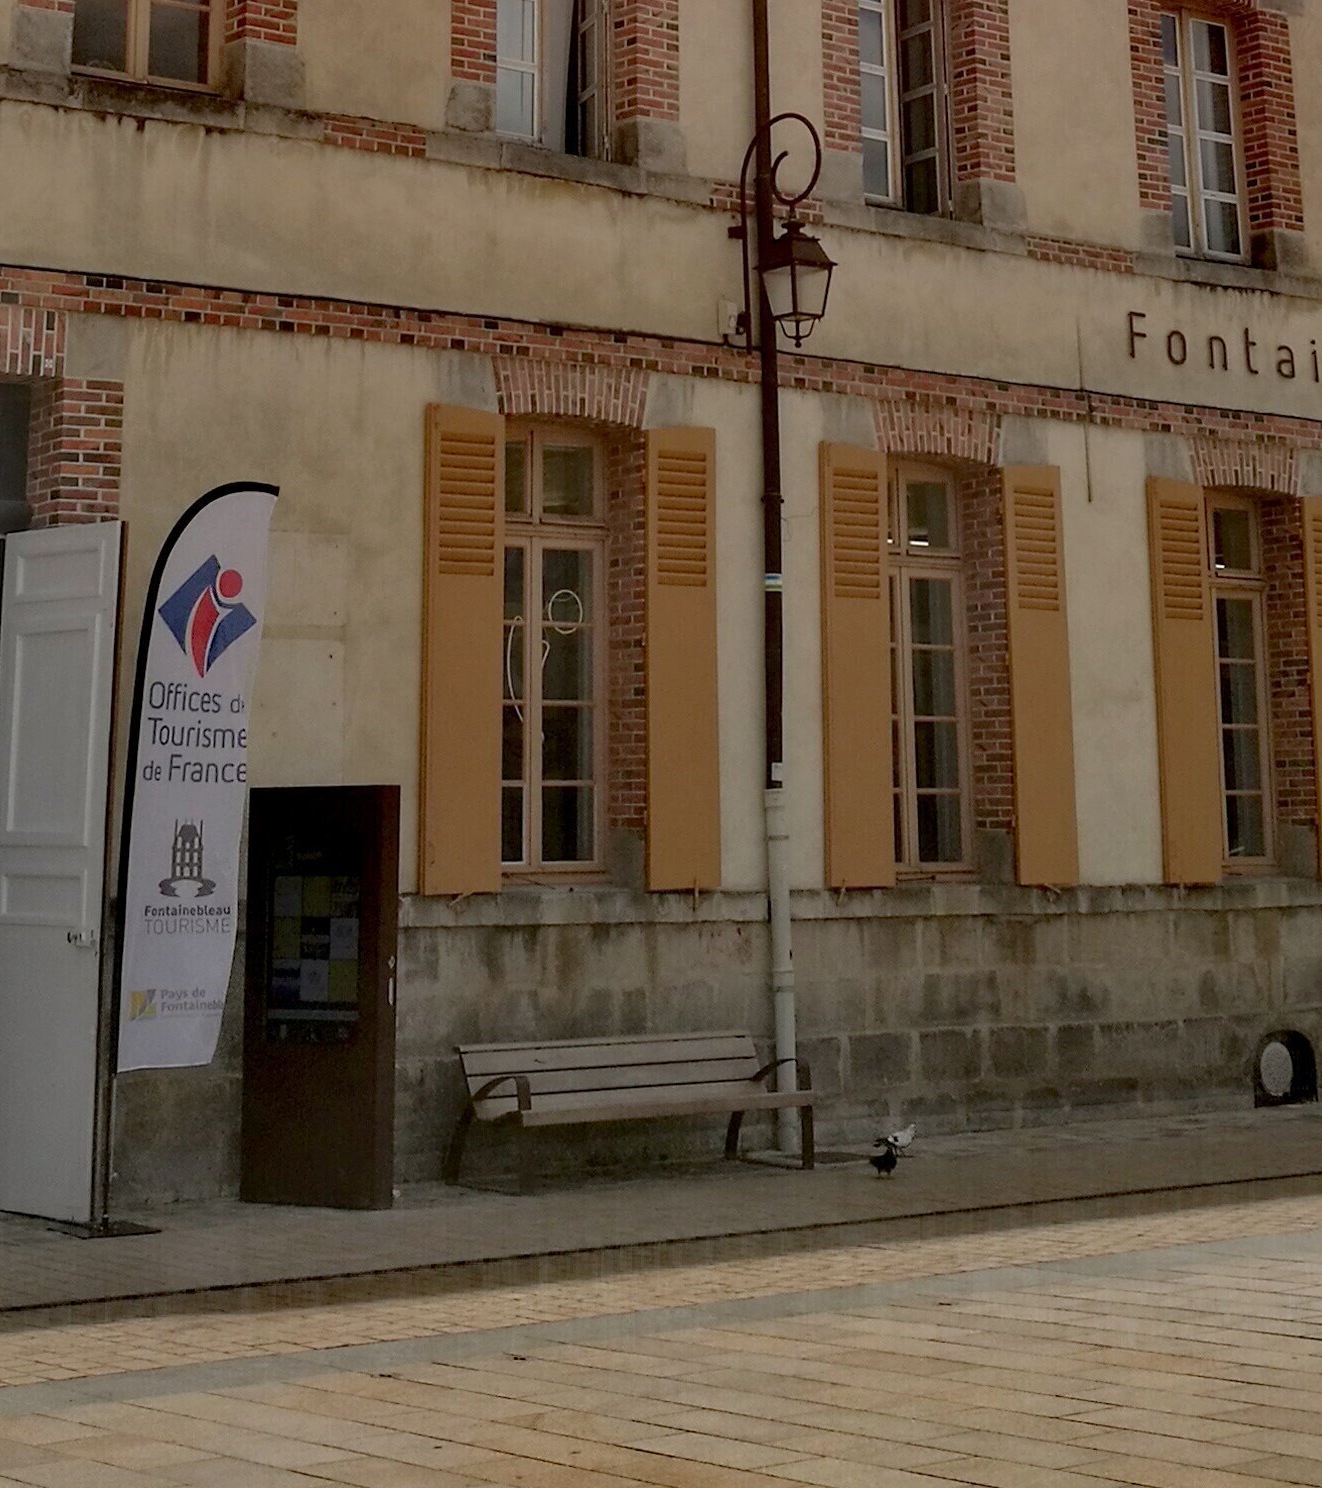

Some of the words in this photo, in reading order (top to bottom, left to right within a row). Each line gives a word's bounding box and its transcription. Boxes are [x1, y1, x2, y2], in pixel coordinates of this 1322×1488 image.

[148, 681, 222, 714] Offices
[147, 717, 247, 749] Tourisme
[142, 760, 162, 782] de
[167, 753, 247, 783] France
[144, 903, 232, 917] Fontainebleau
[144, 917, 232, 936] TOURISME
[160, 989, 189, 1001] Pays
[191, 987, 207, 998] de
